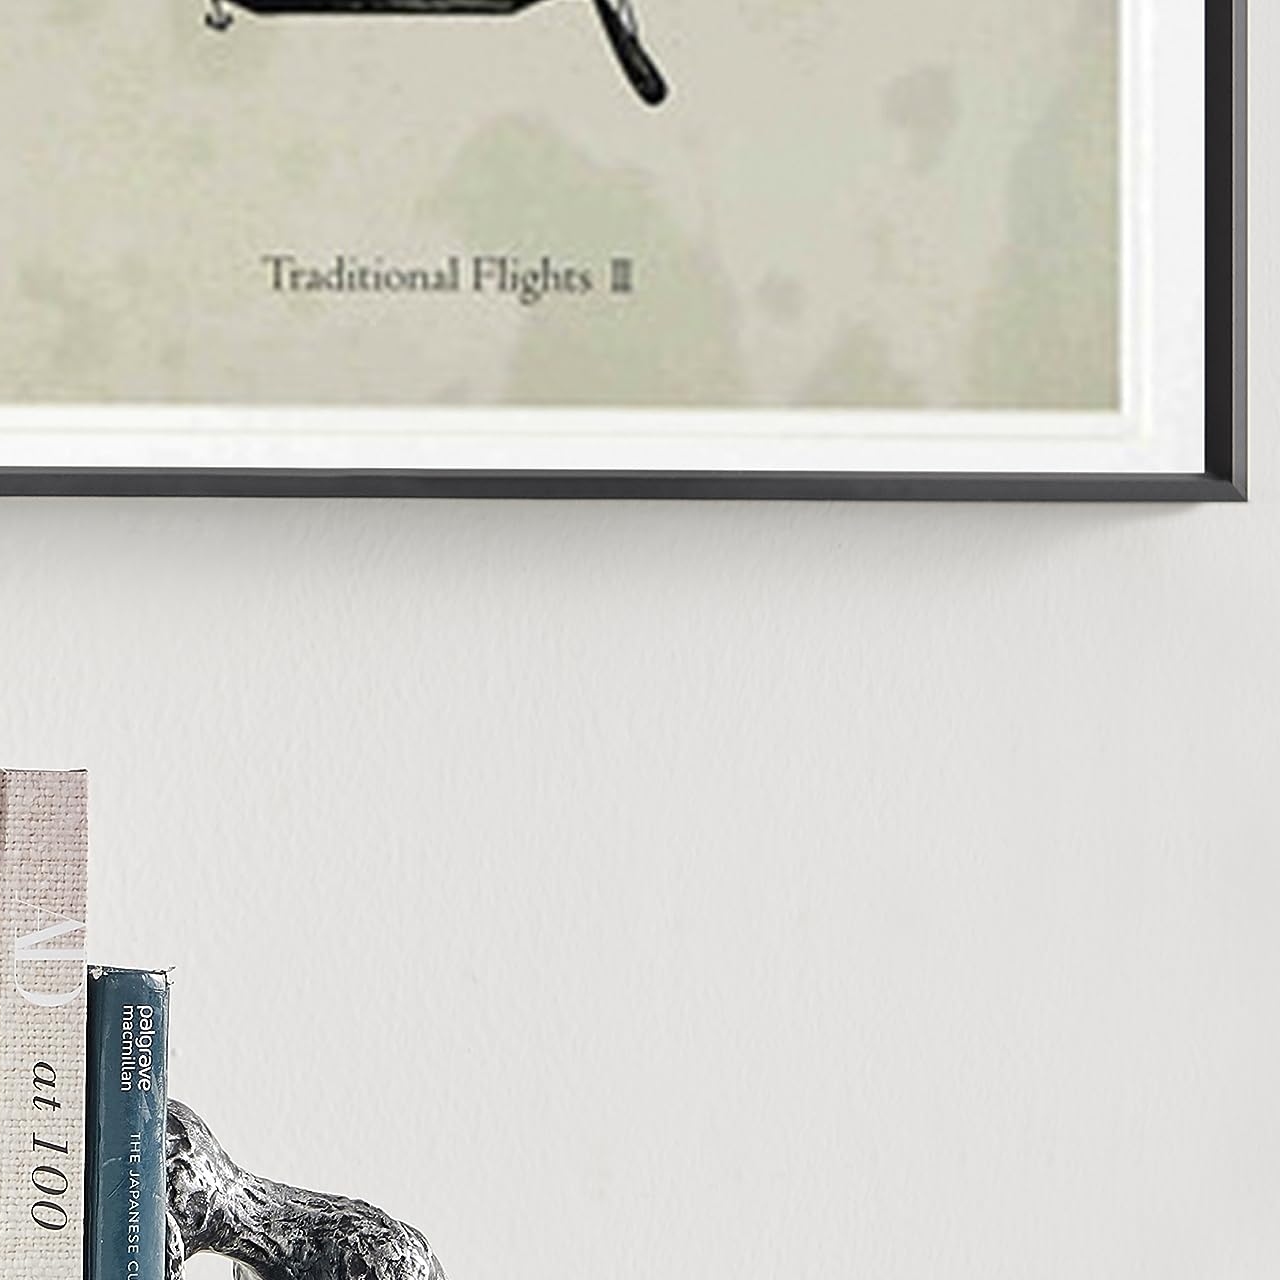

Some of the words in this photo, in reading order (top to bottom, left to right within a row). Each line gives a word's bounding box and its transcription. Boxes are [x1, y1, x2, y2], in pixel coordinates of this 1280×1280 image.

[261, 255, 460, 292] Traditional
[472, 256, 594, 305] Flights
[33, 1061, 62, 1112] at
[120, 1004, 135, 1092] macmillan
[135, 1004, 156, 1092] palgrave
[31, 1132, 69, 1230] 100
[129, 1131, 141, 1163] THE
[126, 1169, 141, 1254] JAPANESE
